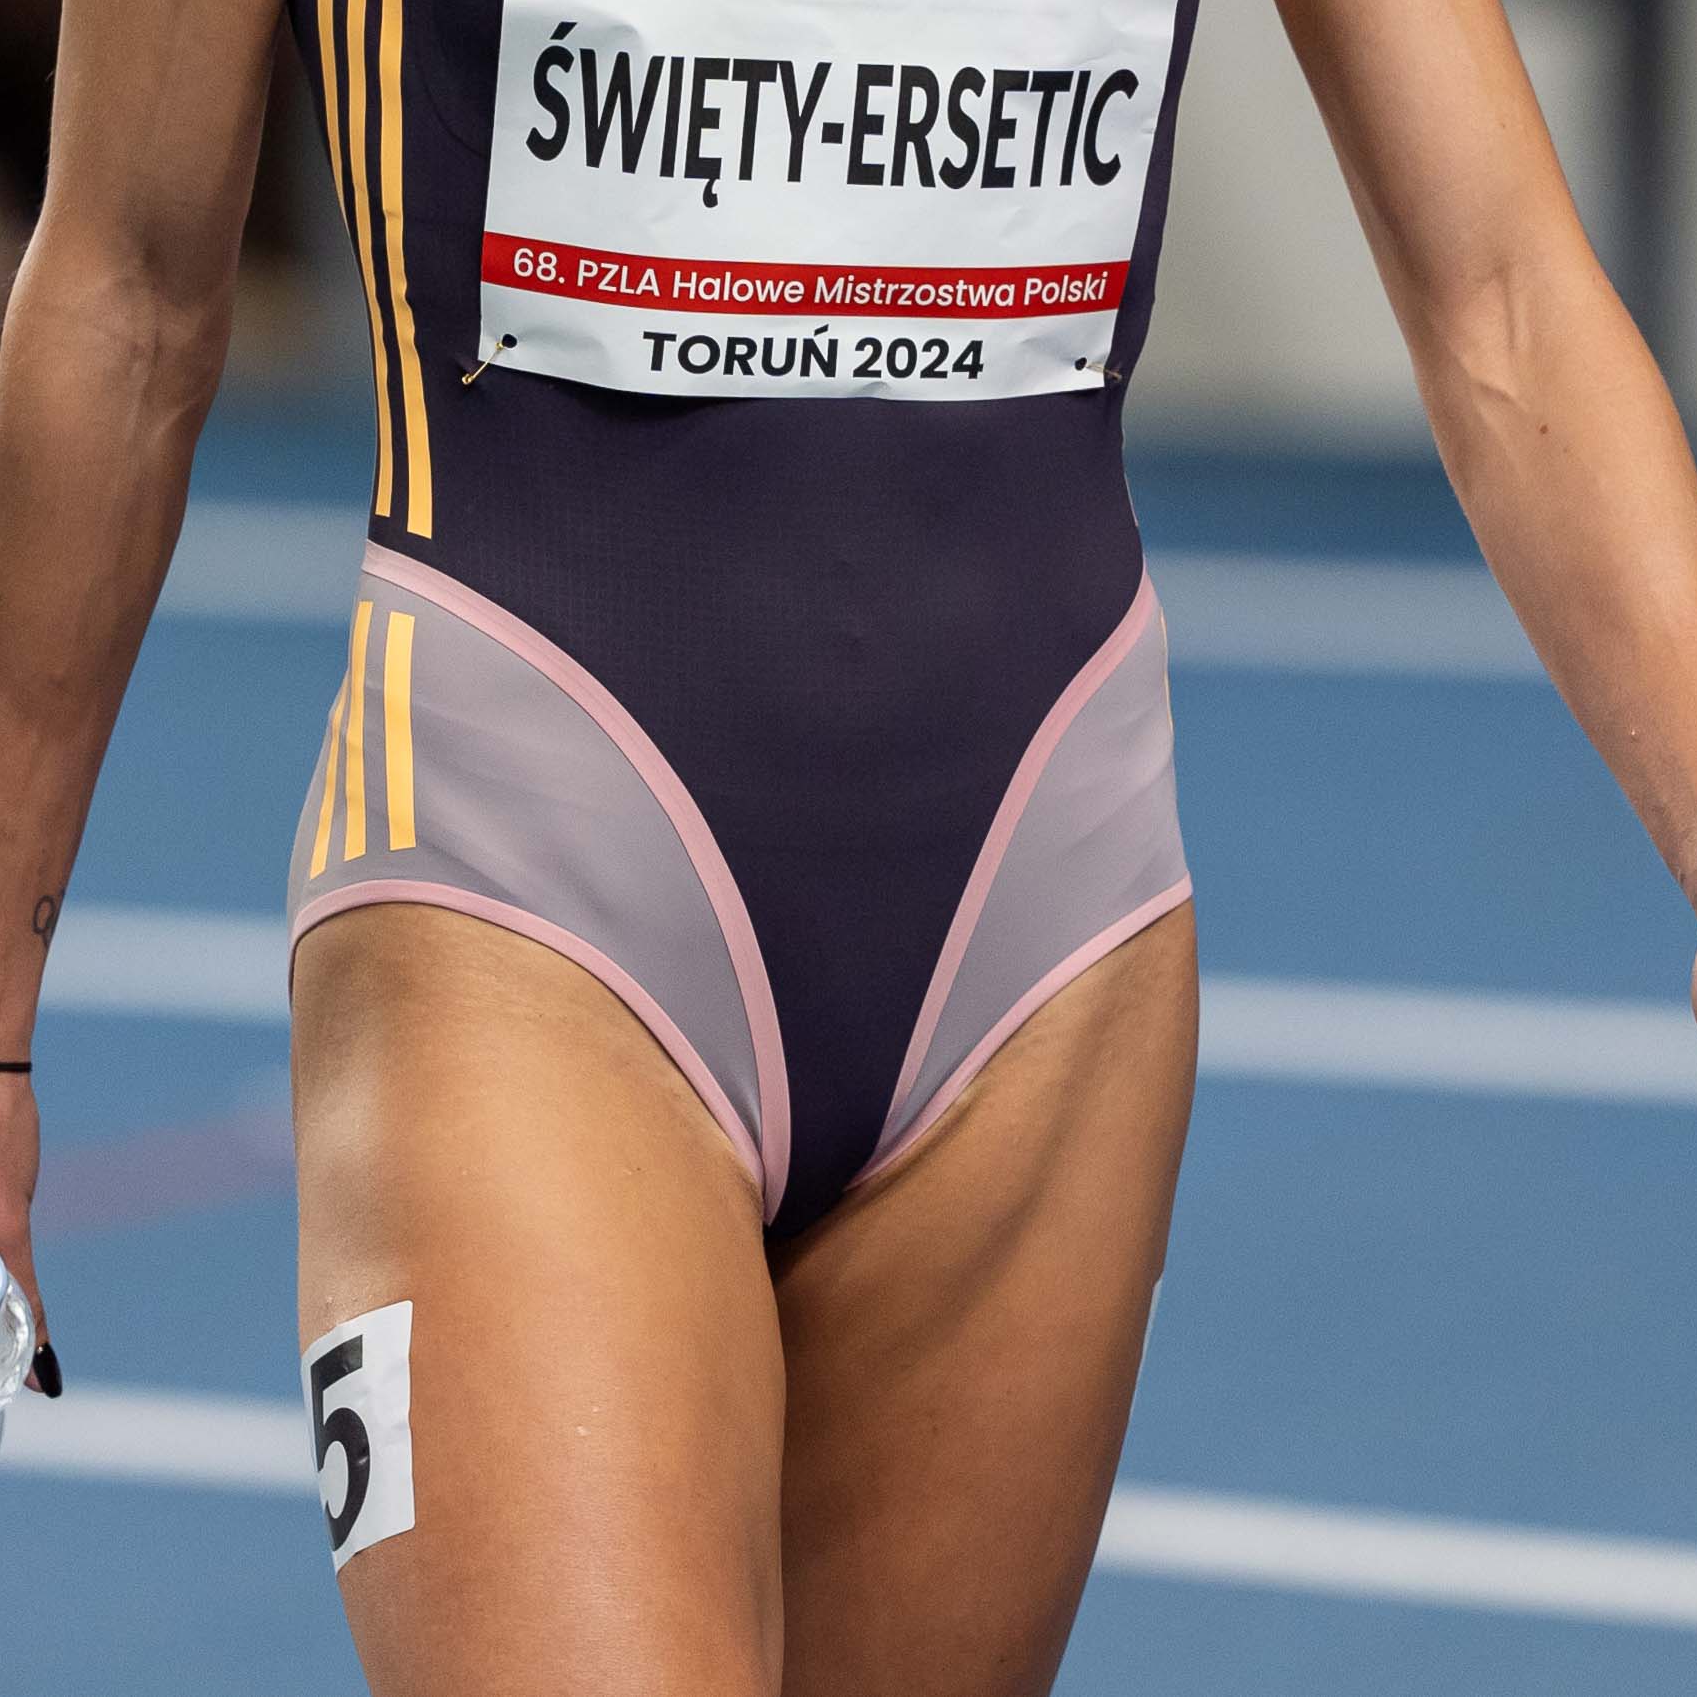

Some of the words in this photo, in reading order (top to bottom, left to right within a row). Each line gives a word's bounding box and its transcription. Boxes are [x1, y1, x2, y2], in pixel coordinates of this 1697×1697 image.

[525, 21, 1140, 209] ŚWIĘTY-ERSETIC
[512, 248, 566, 286] 68.
[577, 259, 661, 298] PZLA
[671, 270, 805, 305] Halowe
[813, 276, 1016, 309] Mistrzostwa
[1023, 271, 1108, 306] Polski
[642, 324, 839, 378] TORUŃ
[853, 337, 984, 380] 2024
[310, 1334, 371, 1551] 5
